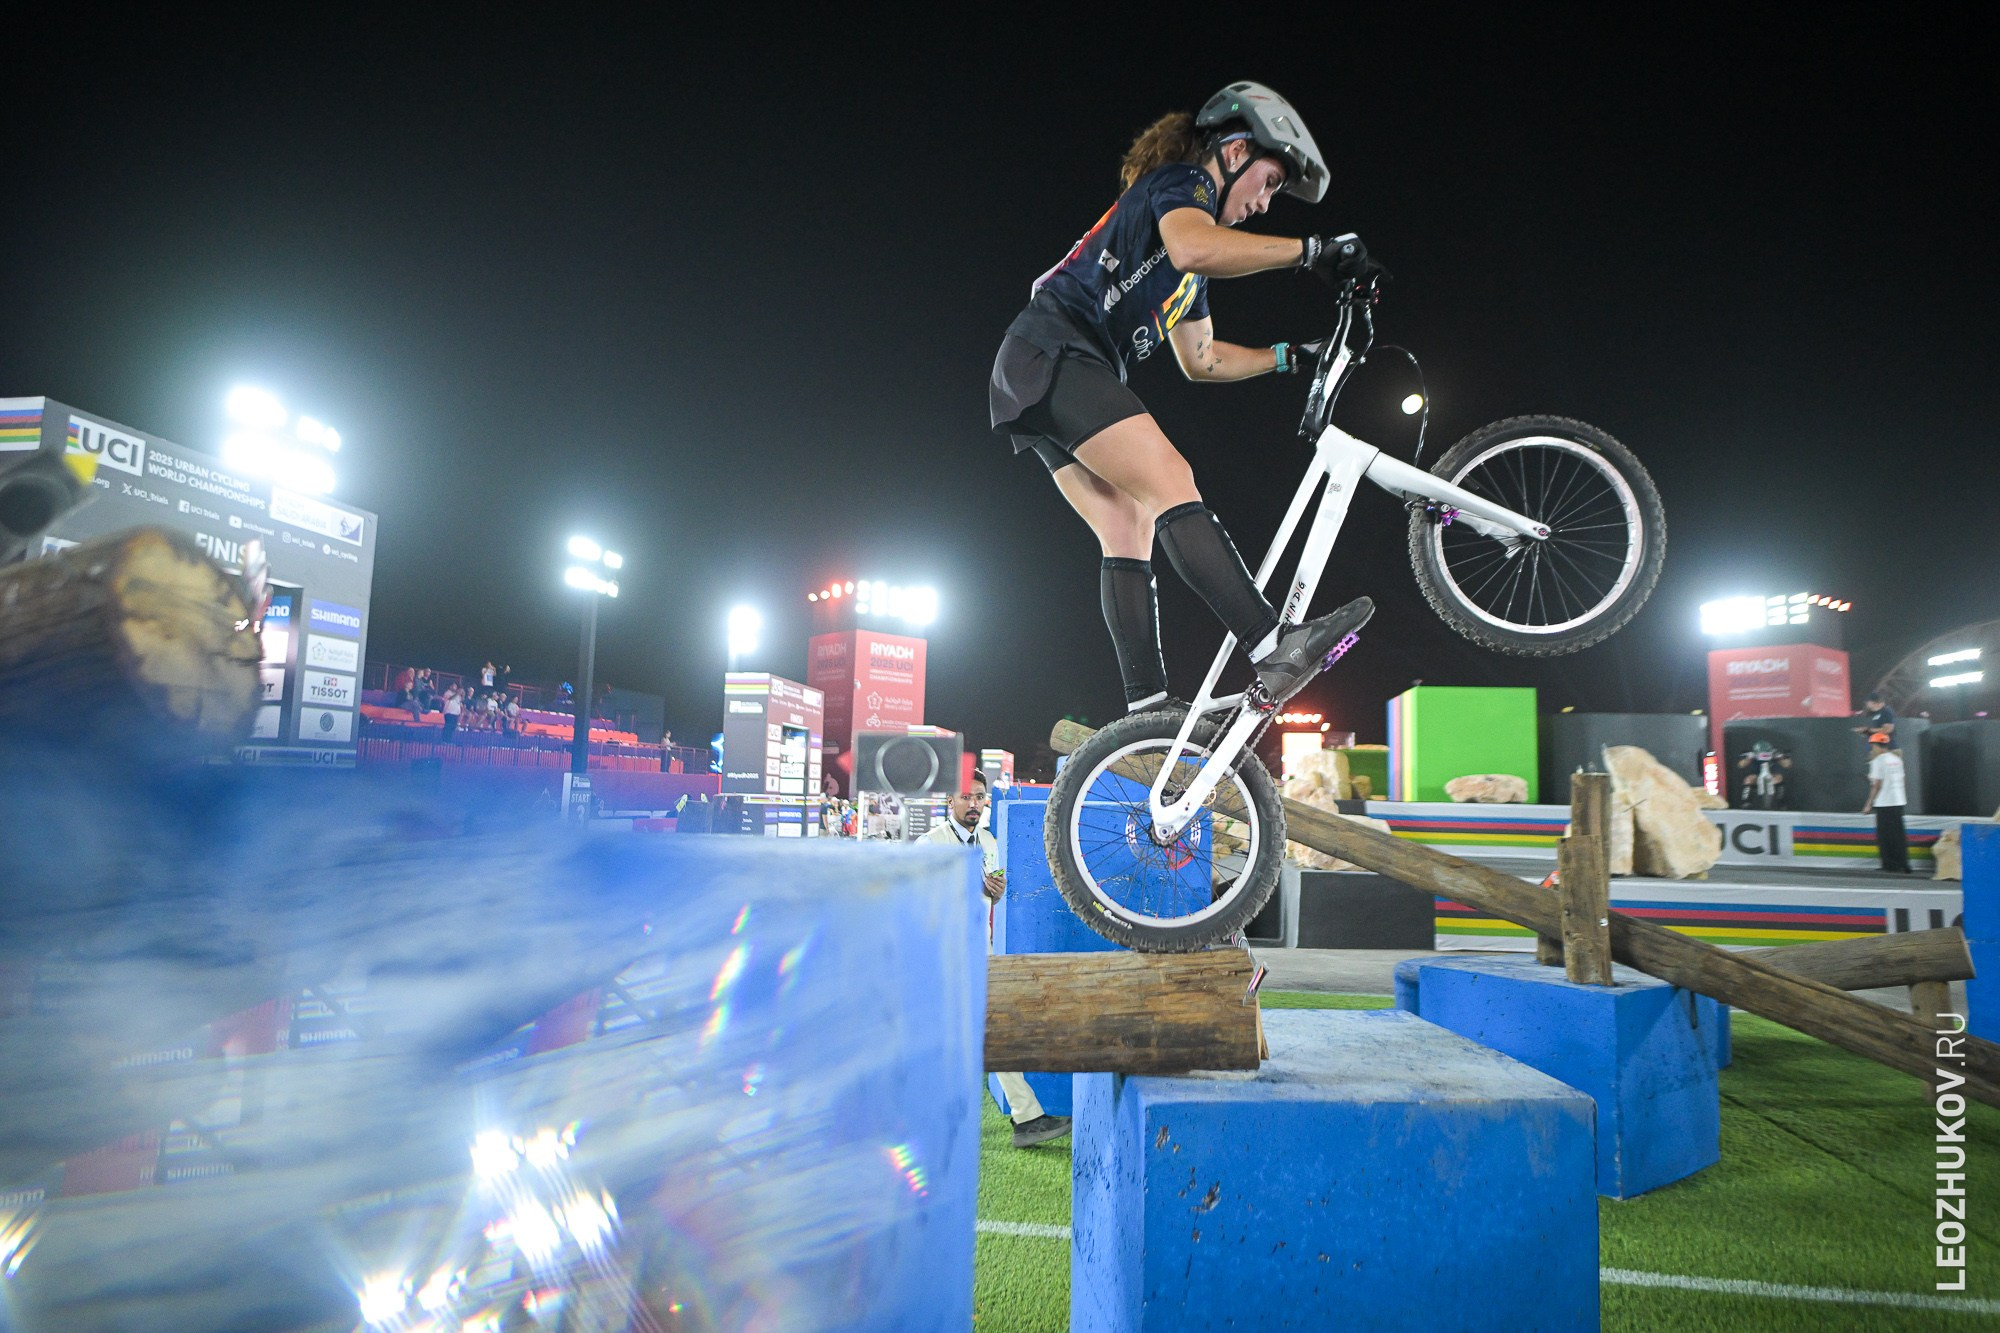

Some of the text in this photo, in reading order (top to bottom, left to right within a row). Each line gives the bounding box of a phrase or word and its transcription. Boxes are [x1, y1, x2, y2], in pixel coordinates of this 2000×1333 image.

[1119, 245, 1168, 293] Iberdrola
[82, 427, 139, 468] UCI
[149, 450, 250, 492] 2025 URBAN CYCLING
[148, 462, 186, 484] WORLD
[188, 476, 266, 510] CHAMPIONSHIPS
[195, 532, 247, 564] FINIS
[311, 608, 360, 628] SHIMANO
[870, 641, 914, 660] RIYADH
[870, 658, 913, 671] 2025 UCI
[310, 685, 348, 699] TISSOT
[313, 752, 334, 764] UCI
[571, 793, 590, 803] START
[1716, 823, 1779, 856] CI
